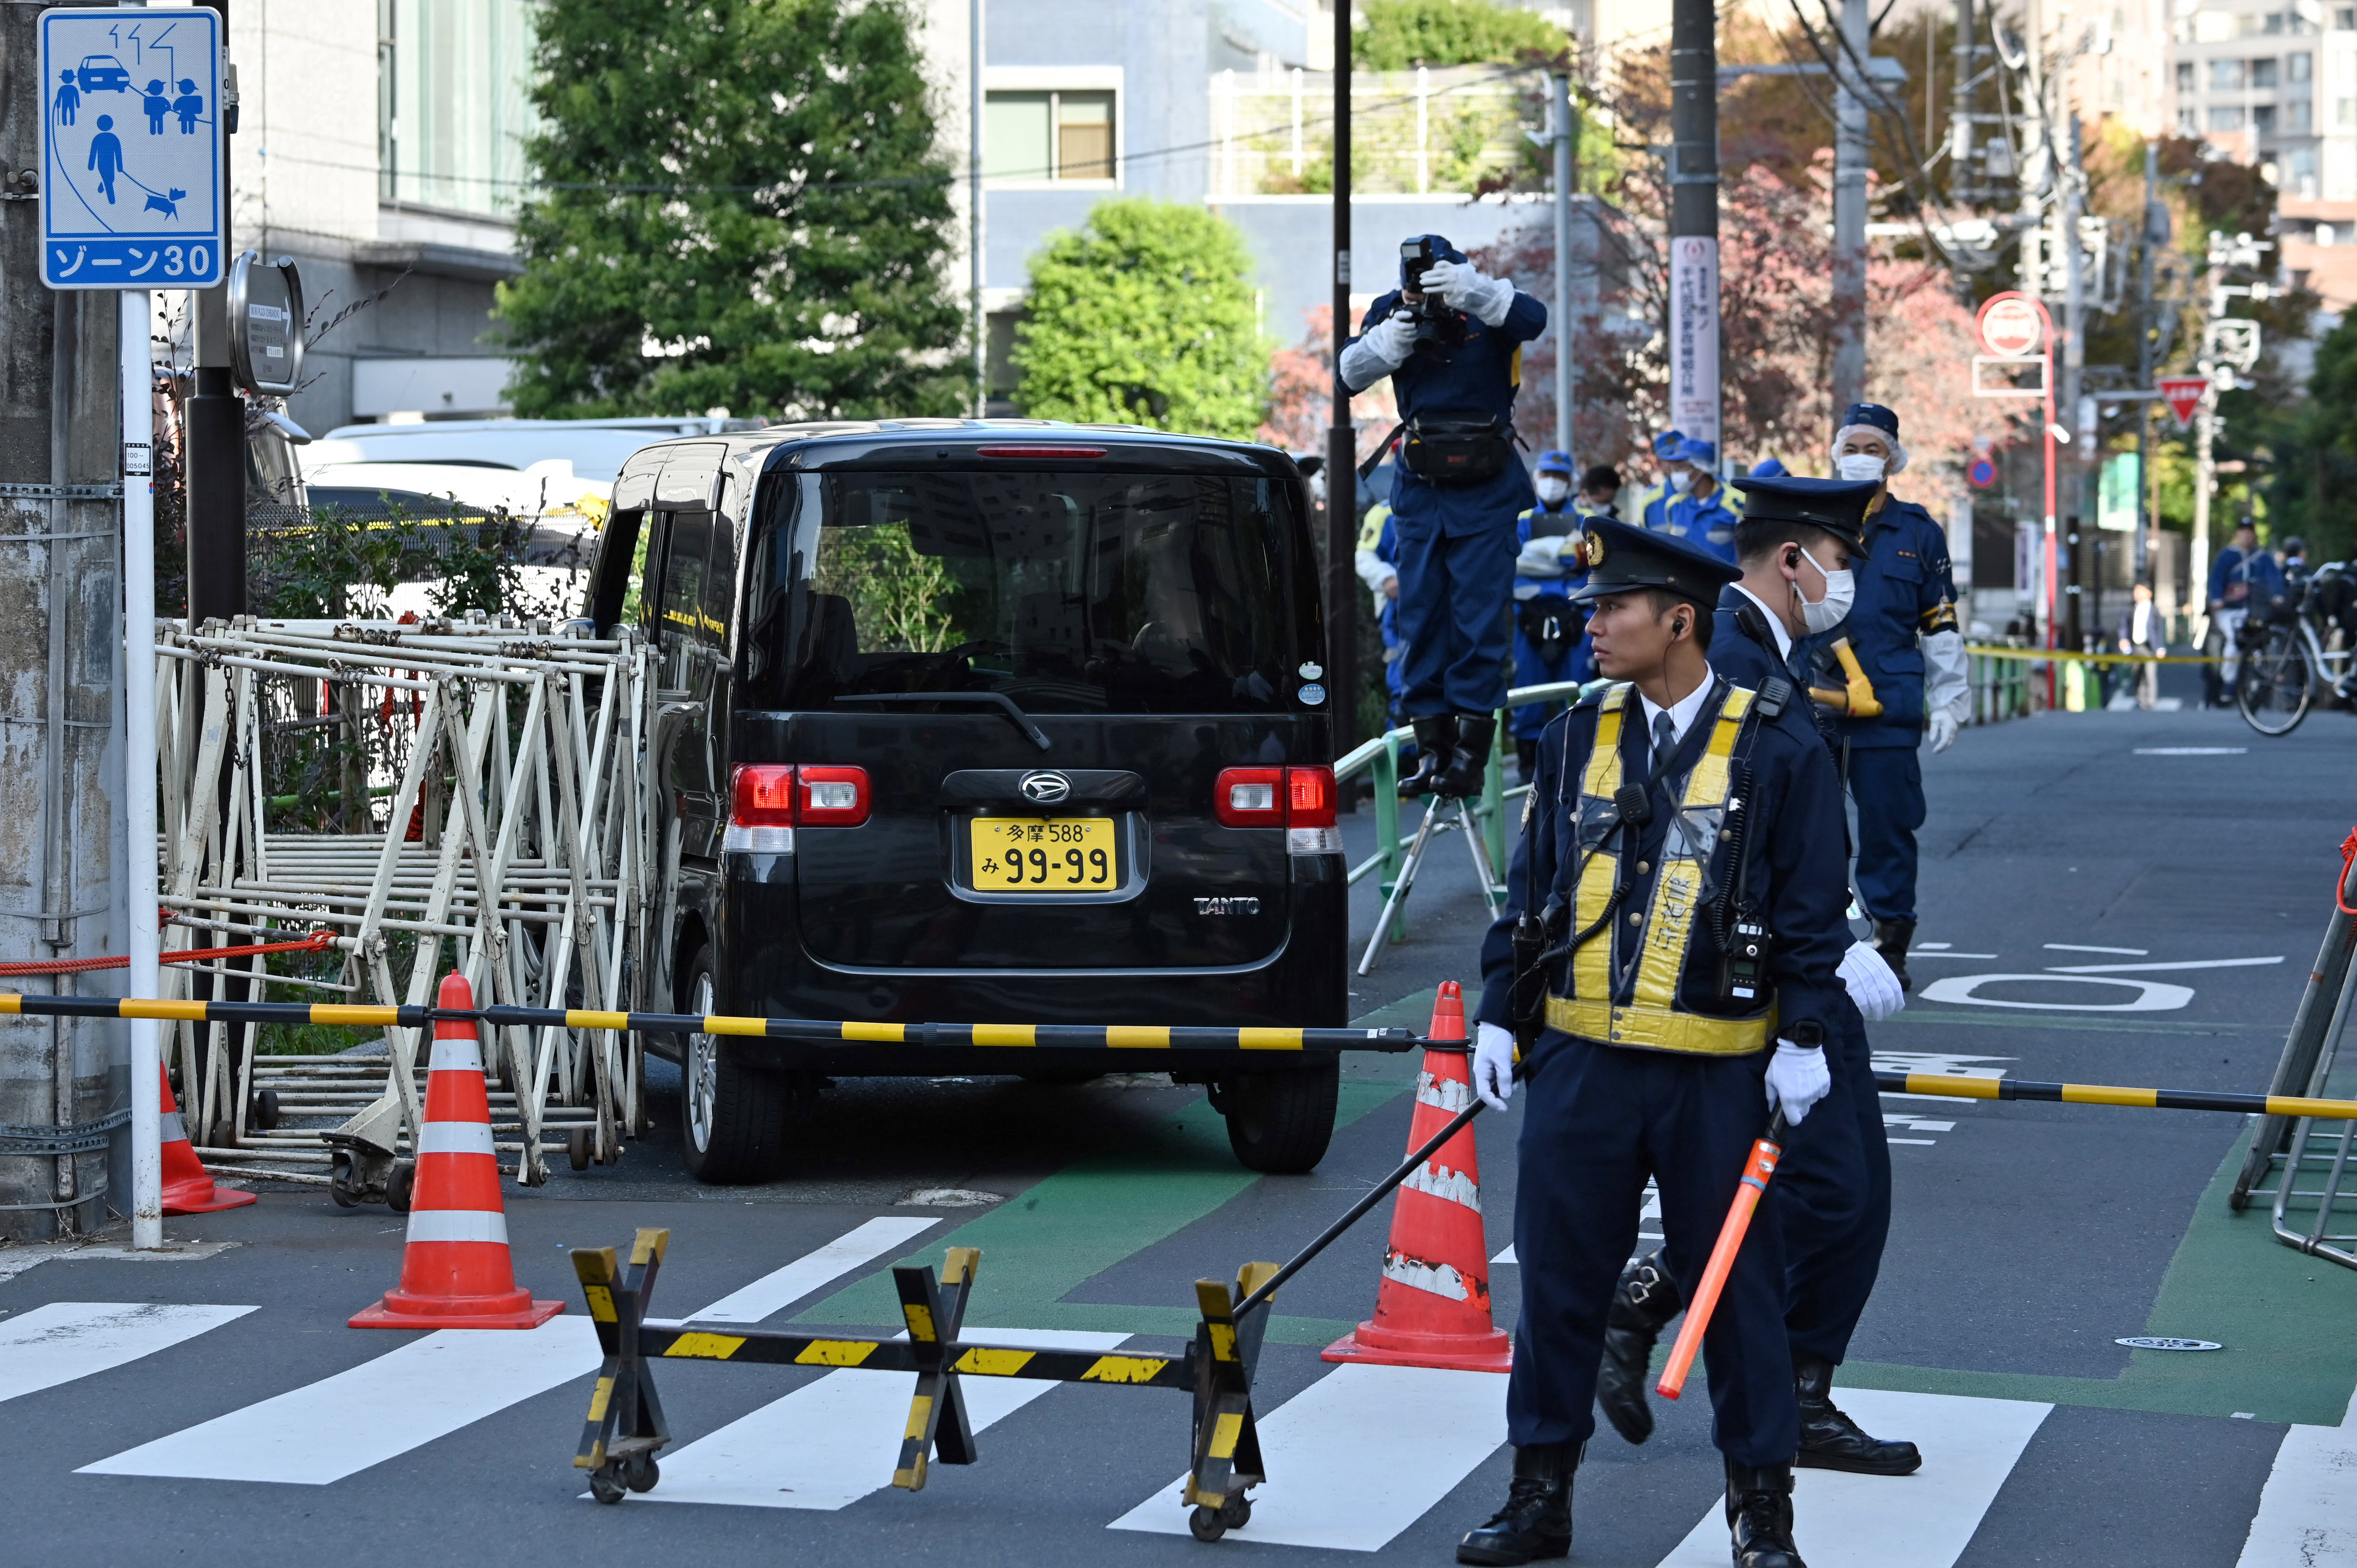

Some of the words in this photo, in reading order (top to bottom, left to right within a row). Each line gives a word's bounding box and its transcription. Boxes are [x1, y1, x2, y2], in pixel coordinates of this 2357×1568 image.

[56, 245, 209, 278] ゾーン30
[1007, 824, 1044, 842] 多摩
[1049, 824, 1083, 842] 588
[981, 858, 999, 874] み
[1005, 848, 1108, 883] 99-99
[1194, 897, 1260, 915] TANTO
